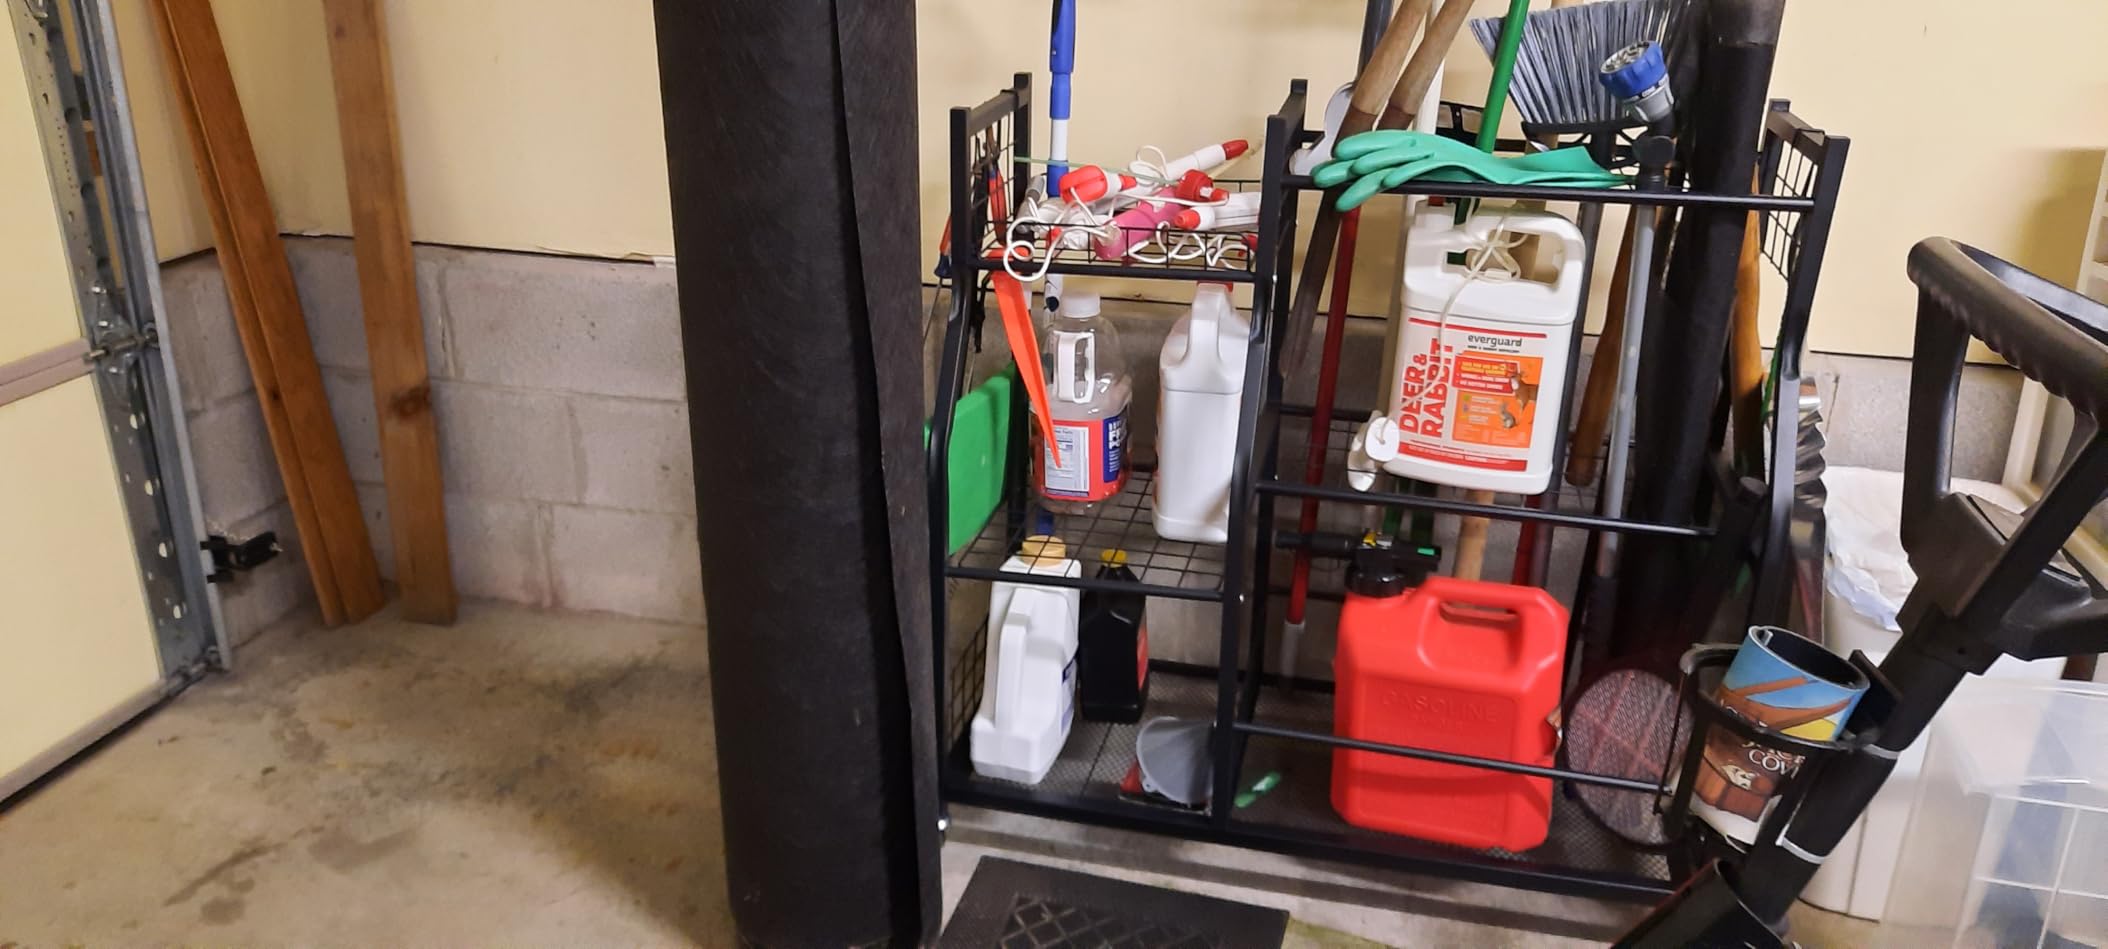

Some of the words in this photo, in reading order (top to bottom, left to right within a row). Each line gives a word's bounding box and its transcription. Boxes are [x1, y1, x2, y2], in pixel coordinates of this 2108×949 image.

[1467, 334, 1523, 348] everguard
[1399, 366, 1426, 434] DEER
[1413, 353, 1427, 366] &
[1420, 337, 1453, 438] RABBIT
